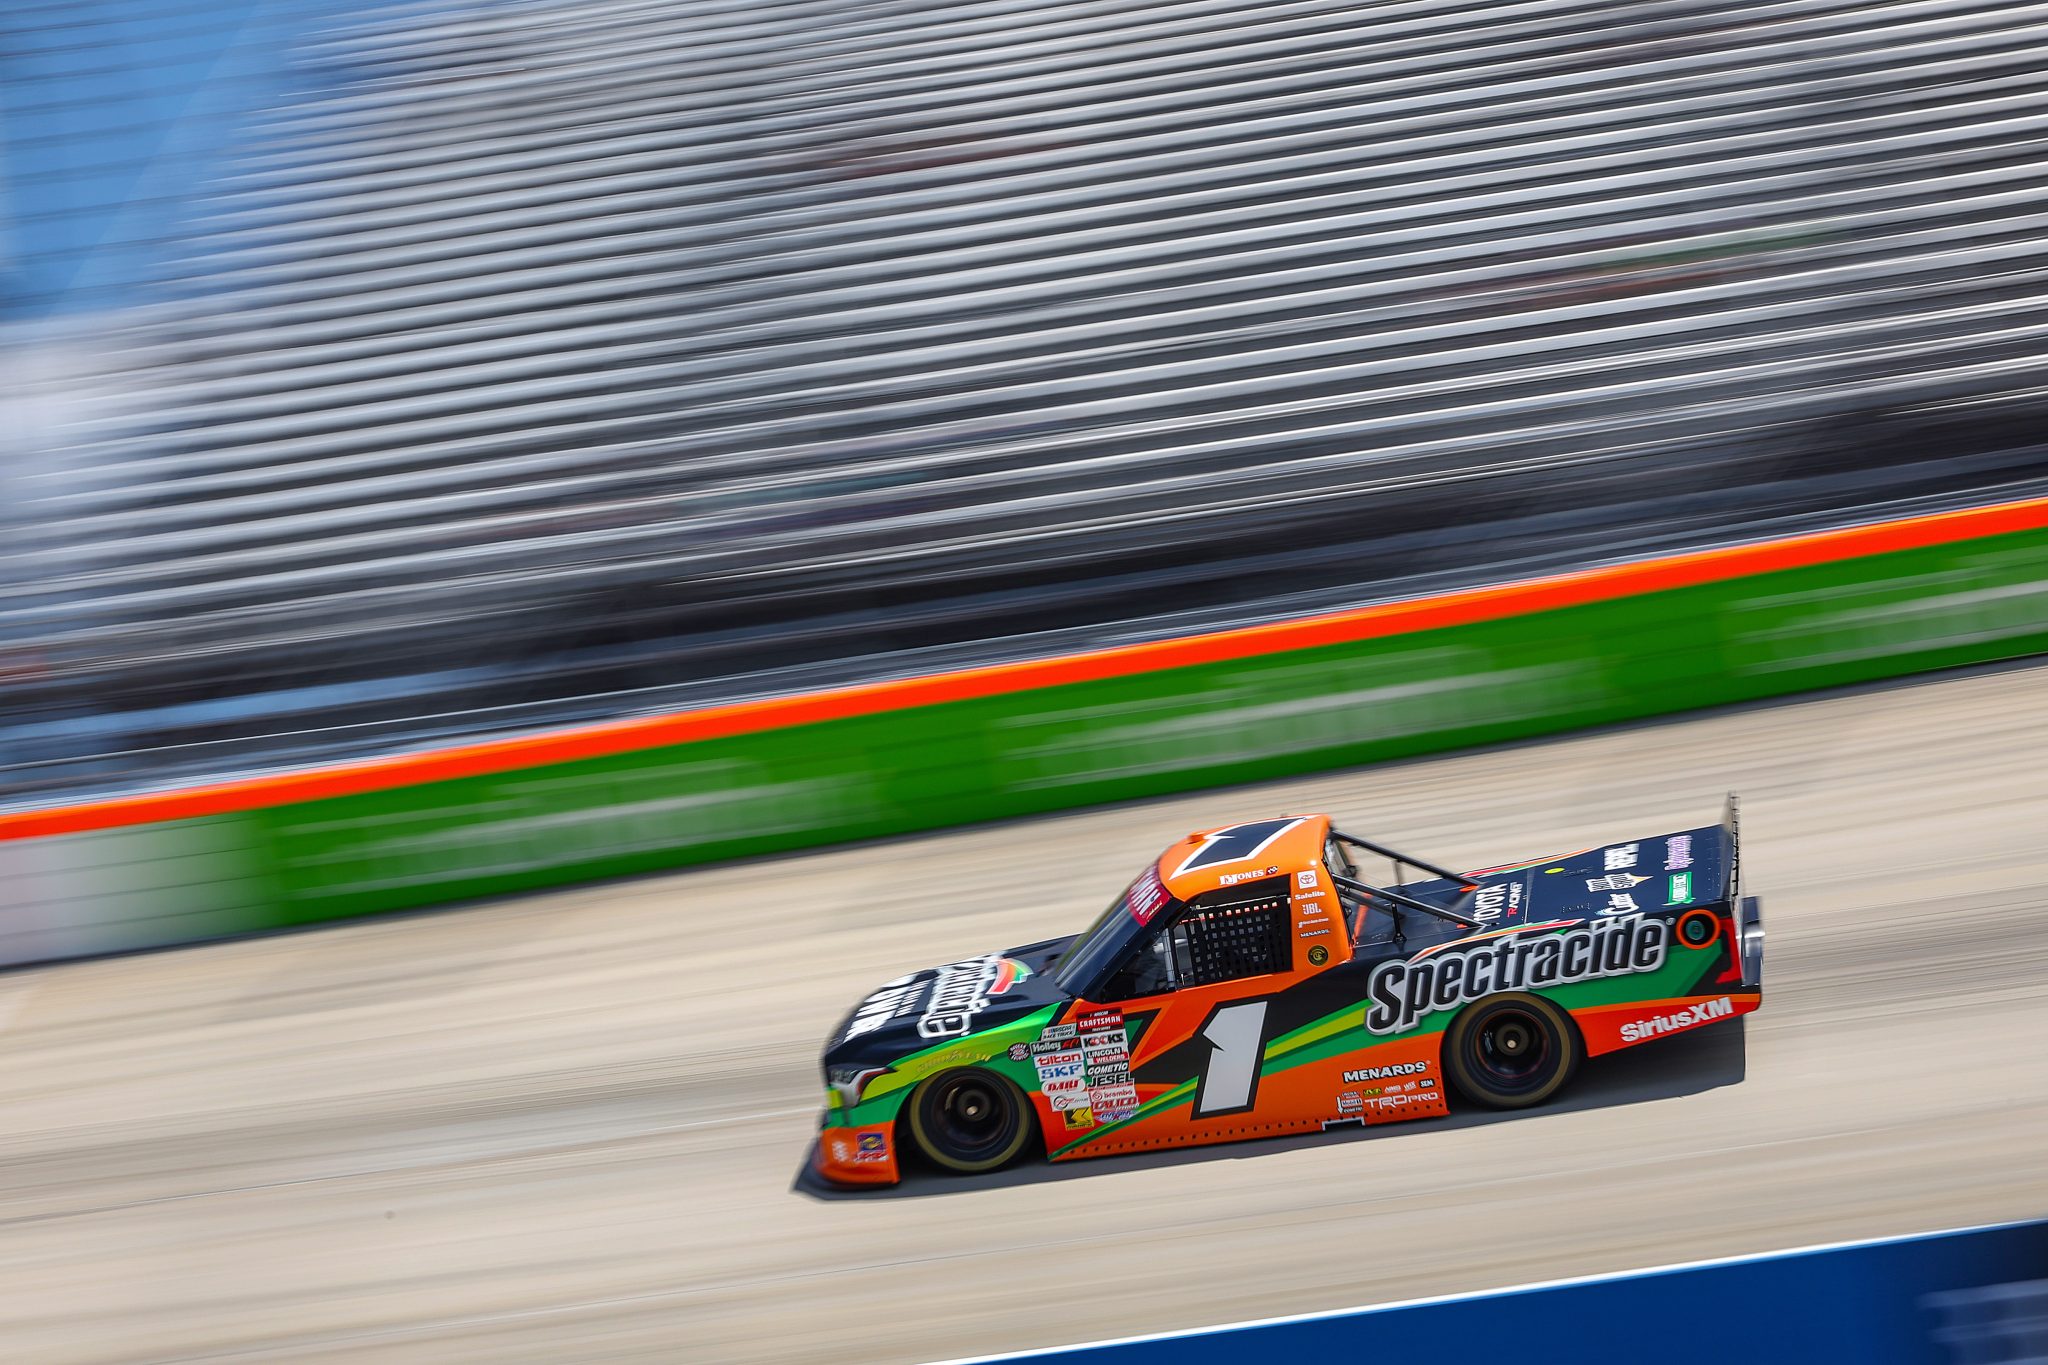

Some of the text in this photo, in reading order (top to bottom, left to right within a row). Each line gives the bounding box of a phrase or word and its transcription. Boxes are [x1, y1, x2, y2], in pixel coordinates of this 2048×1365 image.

[1295, 891, 1326, 900] Safelite
[1474, 884, 1507, 921] TOYOTA
[1302, 903, 1322, 915] JBL
[1366, 914, 1669, 1035] Spectracide
[1080, 1015, 1121, 1028] CRAFTSMAN
[1620, 997, 1734, 1043] SiriusXM
[1032, 1041, 1061, 1053] Holley
[1087, 1047, 1121, 1058] LINCOLN
[1037, 1053, 1081, 1066] tilton
[1200, 1001, 1268, 1112] 1
[1041, 1064, 1082, 1079] SKF
[1343, 1061, 1427, 1083] MENARDS
[1088, 1072, 1134, 1087] JESEL
